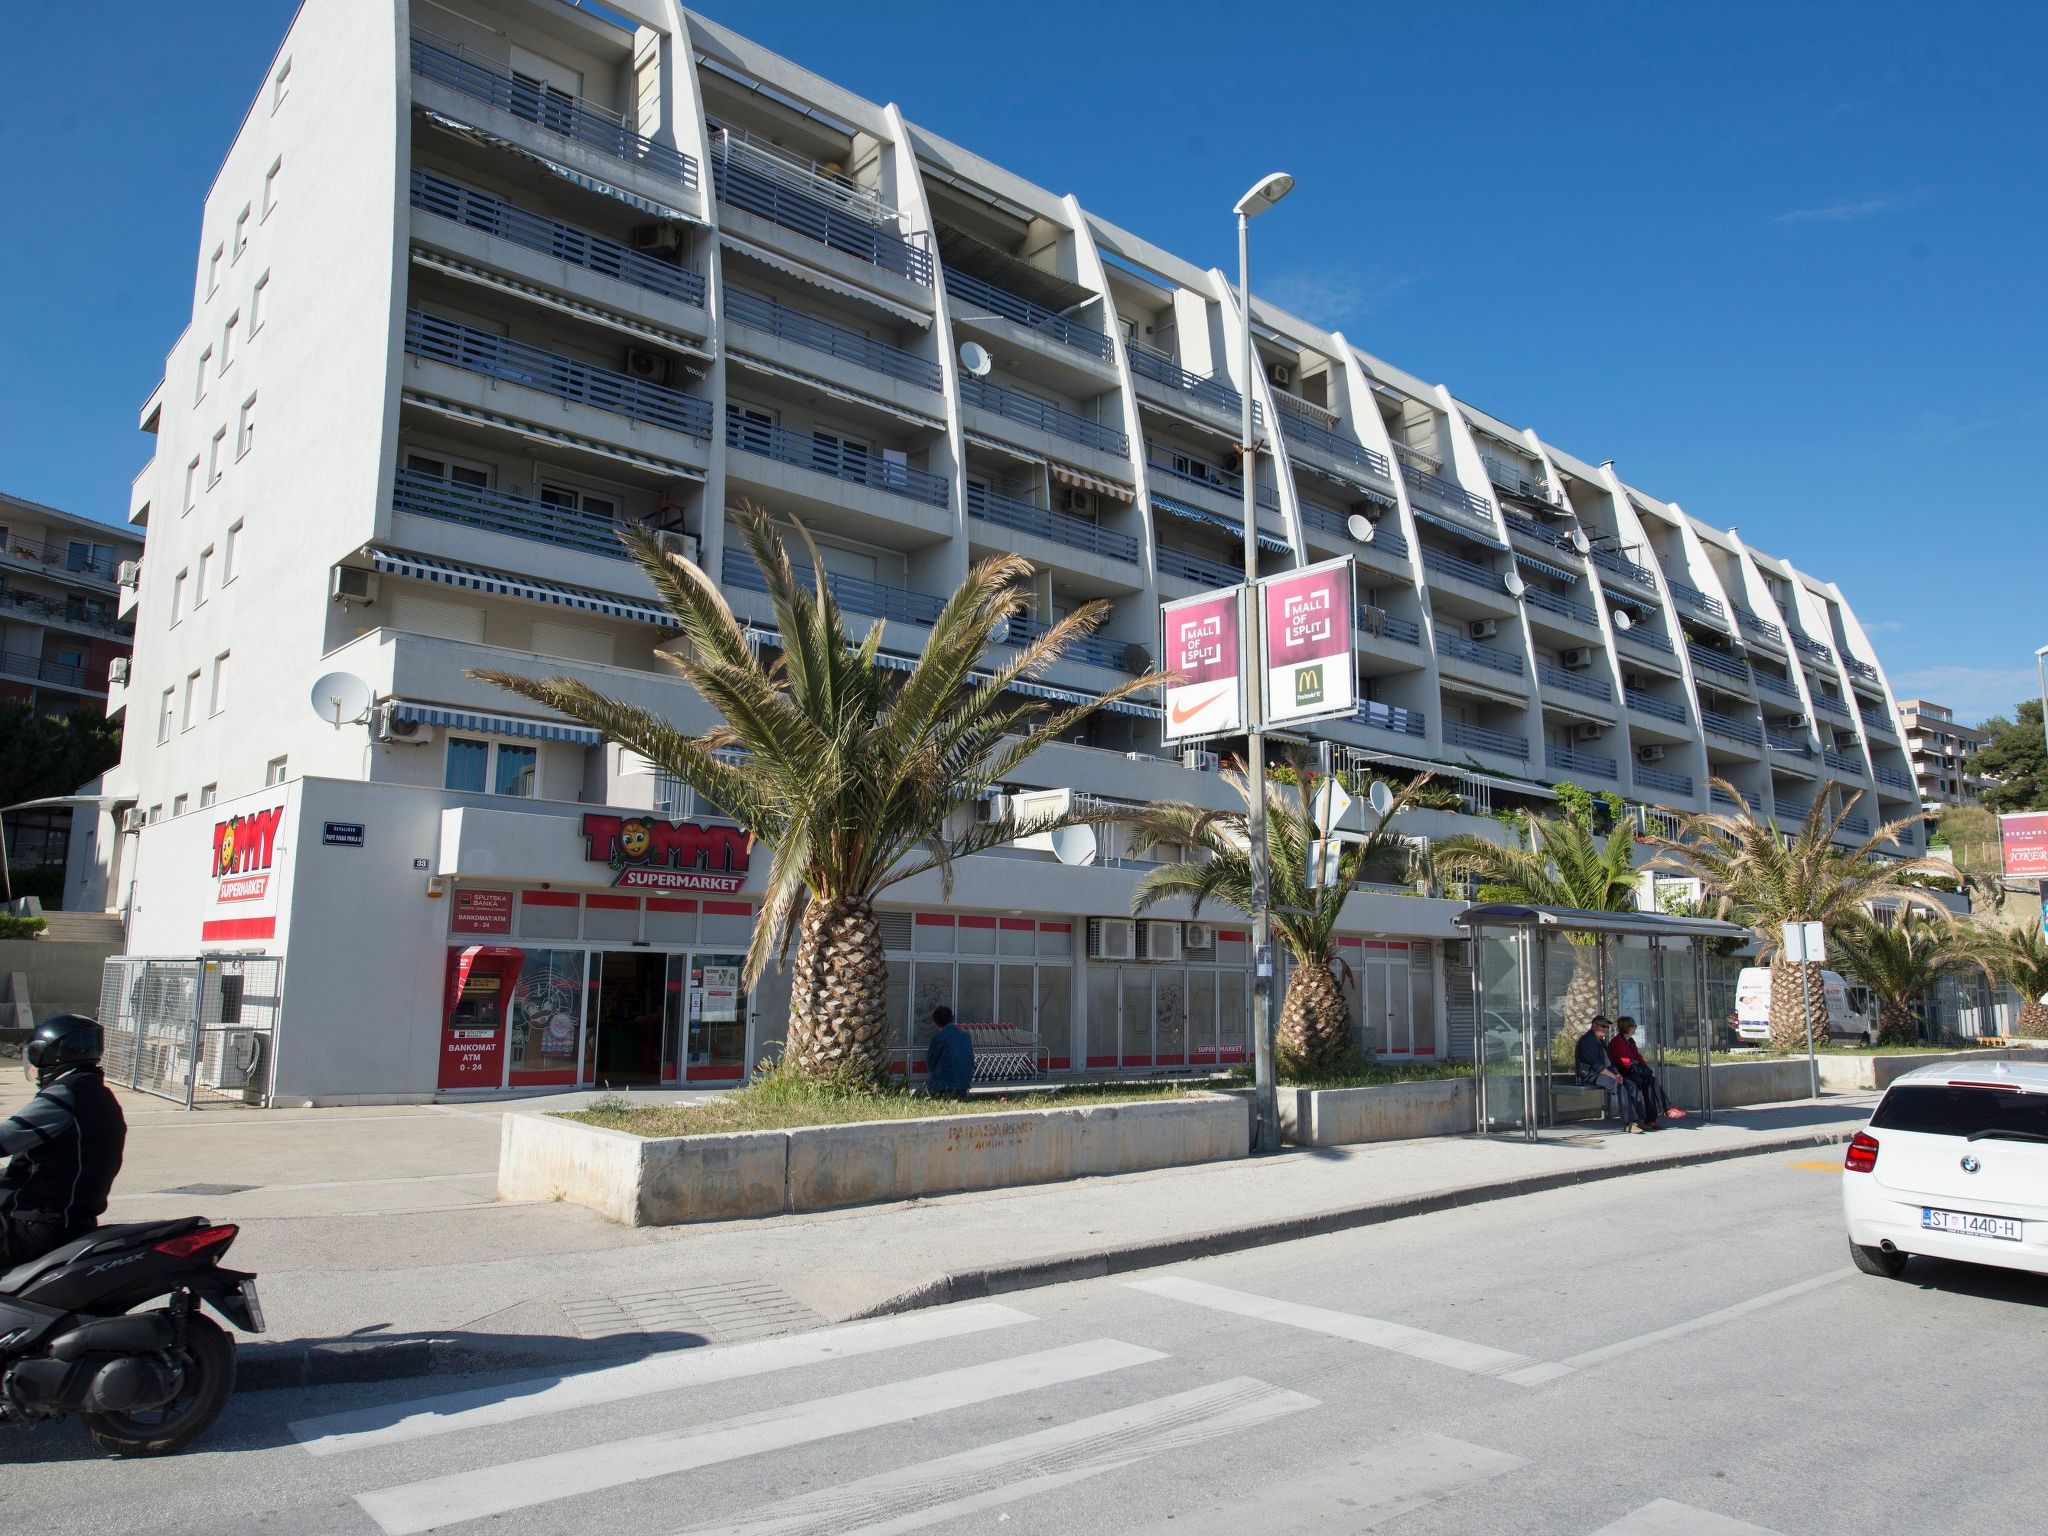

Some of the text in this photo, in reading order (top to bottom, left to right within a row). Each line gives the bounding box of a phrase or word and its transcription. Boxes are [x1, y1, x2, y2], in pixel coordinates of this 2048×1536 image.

[1292, 600, 1322, 615] MALL
[1293, 614, 1307, 625] OF
[1187, 626, 1213, 640] MALL
[1293, 621, 1321, 637] SPLIT
[1188, 639, 1201, 649] OF
[1188, 647, 1213, 660] SPLIT
[212, 805, 284, 877] TOMMY
[583, 813, 757, 872] TOMMY
[2008, 851, 2048, 862] JOKER
[221, 879, 265, 898] SUPERMARKET
[627, 872, 738, 891] SUPERMARKET
[473, 894, 507, 902] SPLITSKA
[448, 1043, 496, 1051] BANKOMAT
[462, 1053, 481, 1061] ATM
[1933, 1211, 1949, 1227] ST
[1963, 1215, 2014, 1236] 1440-H
